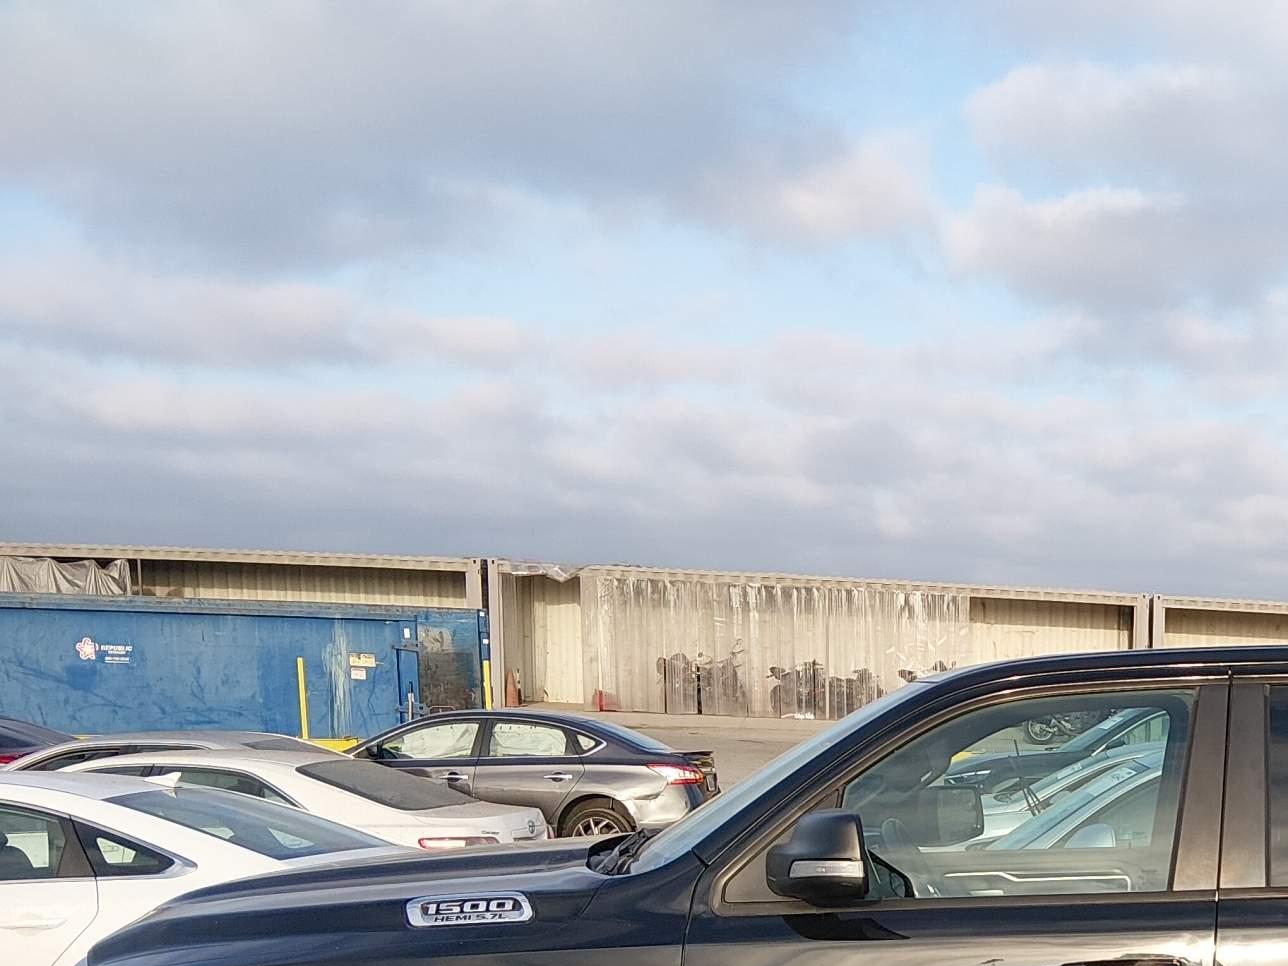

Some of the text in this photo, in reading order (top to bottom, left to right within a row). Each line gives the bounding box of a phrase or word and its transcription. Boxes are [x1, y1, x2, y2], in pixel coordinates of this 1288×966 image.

[425, 899, 515, 916] 1500
[434, 913, 508, 923] HEMI 5.7L
